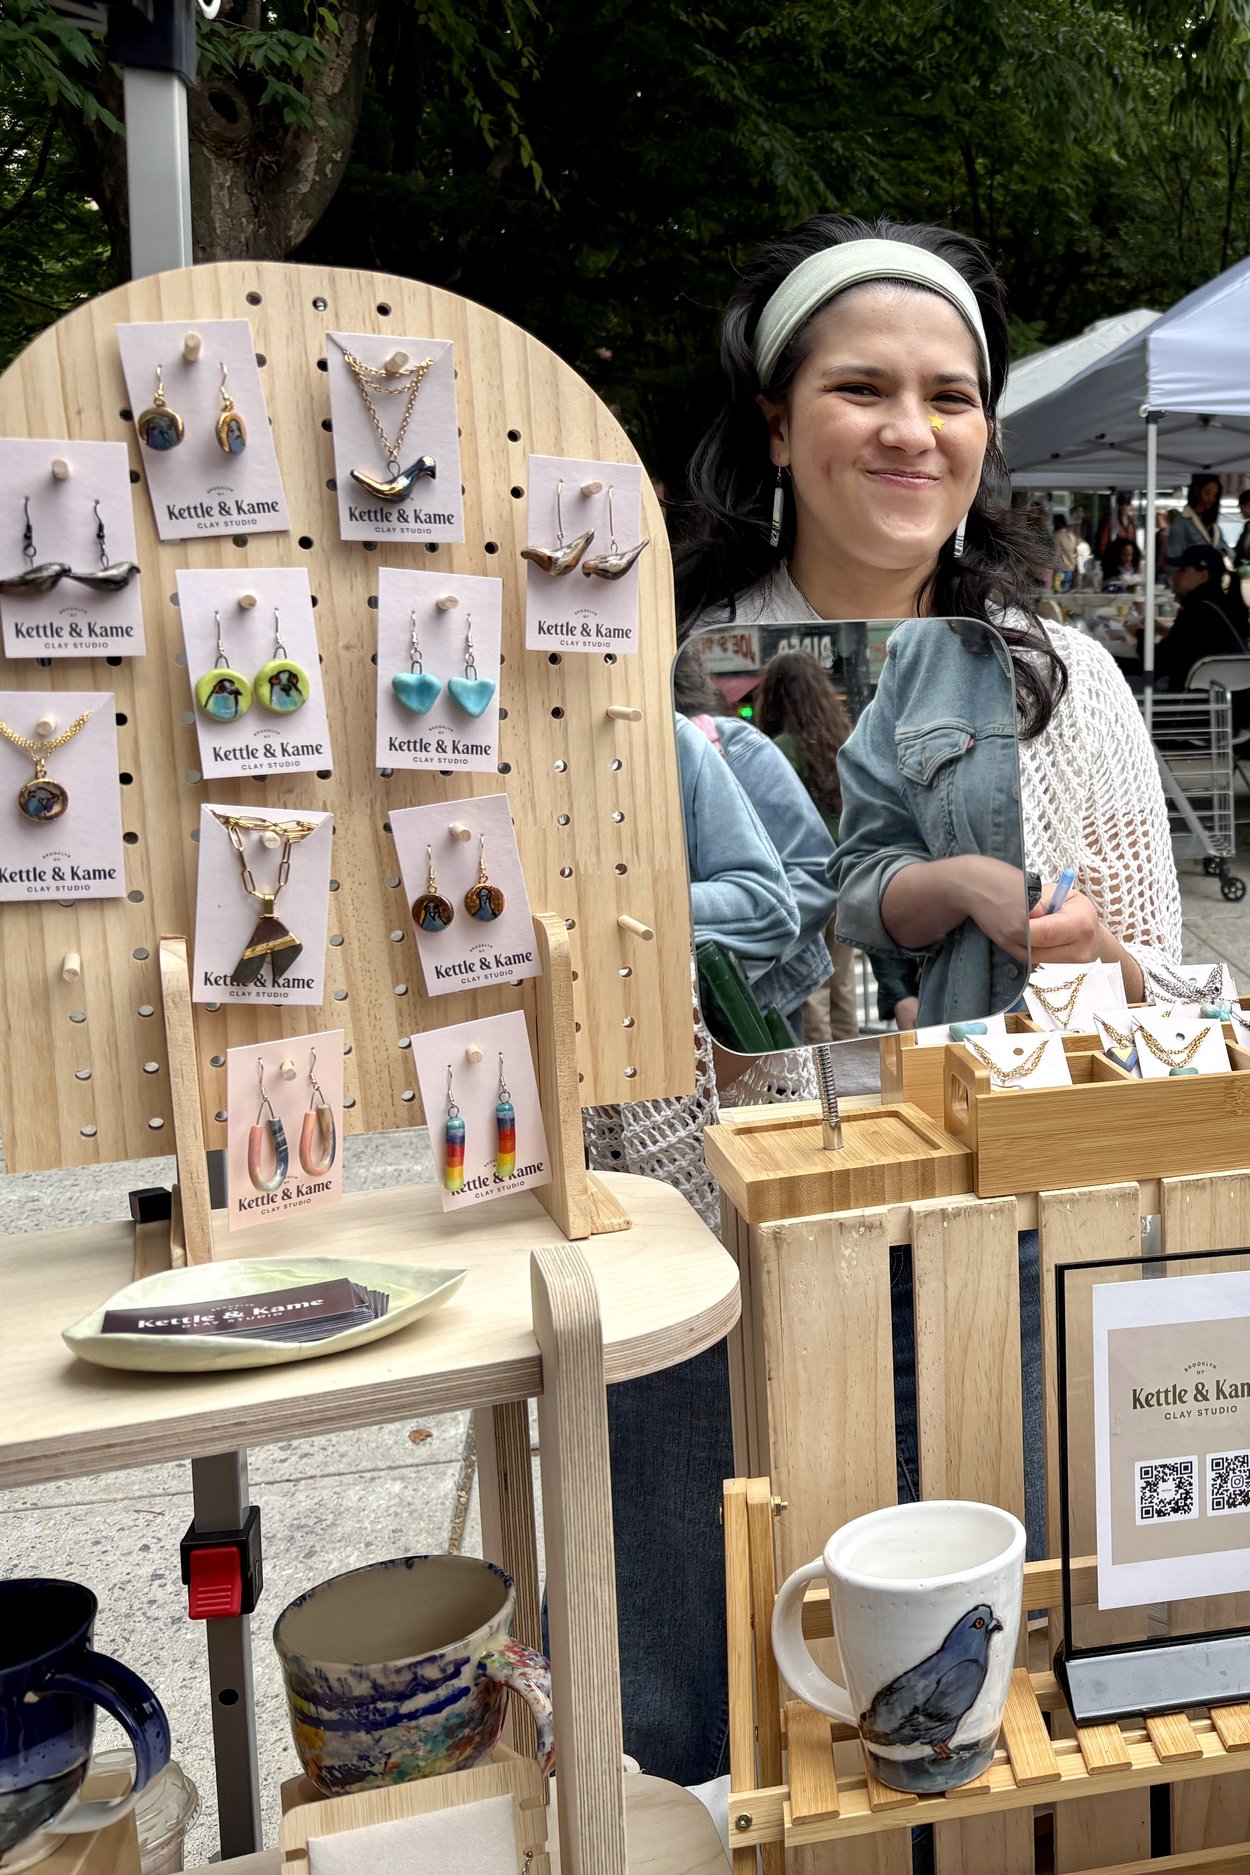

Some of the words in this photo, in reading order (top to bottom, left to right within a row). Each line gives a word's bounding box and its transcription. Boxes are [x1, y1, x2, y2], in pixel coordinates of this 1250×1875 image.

[166, 501, 215, 521] Kettle
[217, 500, 233, 517] &
[234, 499, 280, 516] Kame
[348, 506, 393, 523] Kettle
[396, 508, 411, 524] &
[413, 508, 455, 525] Kame
[196, 521, 220, 530] CLAY
[223, 518, 258, 528] STUDIO
[374, 526, 397, 534] CLAY
[400, 527, 433, 535] STUDIO
[14, 621, 64, 639] Kettle
[68, 622, 84, 638] &
[87, 621, 134, 638] Kame
[538, 620, 577, 637] Kettle
[580, 622, 592, 638] &
[595, 623, 632, 639] Kame
[44, 642, 69, 650] CLAY
[72, 641, 109, 649] STUDIO
[582, 640, 611, 648] STUDIO
[212, 744, 259, 762] Kettle
[263, 743, 277, 759] &
[280, 742, 323, 758] Kame
[389, 736, 432, 753] Kettle
[435, 739, 448, 754] &
[452, 739, 492, 756] Kame
[241, 763, 264, 771] CLAY
[267, 760, 301, 769] STUDIO
[437, 757, 469, 765] STUDIO
[0, 866, 47, 883] Kettle
[51, 866, 66, 882] &
[70, 865, 116, 881] Kame
[26, 885, 51, 893] CLAY
[55, 884, 91, 892] STUDIO
[434, 960, 476, 980] Kettle
[479, 956, 492, 971] &
[493, 951, 533, 968] Kame
[203, 971, 249, 987] Ket
[460, 975, 481, 984] CLAY
[483, 969, 514, 980] STUDIO
[238, 1192, 278, 1212] Kettle
[280, 1187, 293, 1201] &
[296, 1180, 332, 1198] Kame
[260, 1205, 281, 1215] CLAY
[283, 1198, 312, 1210] STUDIO
[138, 1314, 215, 1328] Kettle
[222, 1310, 246, 1320] &
[252, 1299, 324, 1316] Kame
[1184, 1361, 1217, 1373] BROOKLYN
[1132, 1383, 1189, 1410] Kettle
[1193, 1381, 1210, 1403] &
[1164, 1409, 1192, 1421] CLAY
[1197, 1405, 1238, 1417] STUDIO
